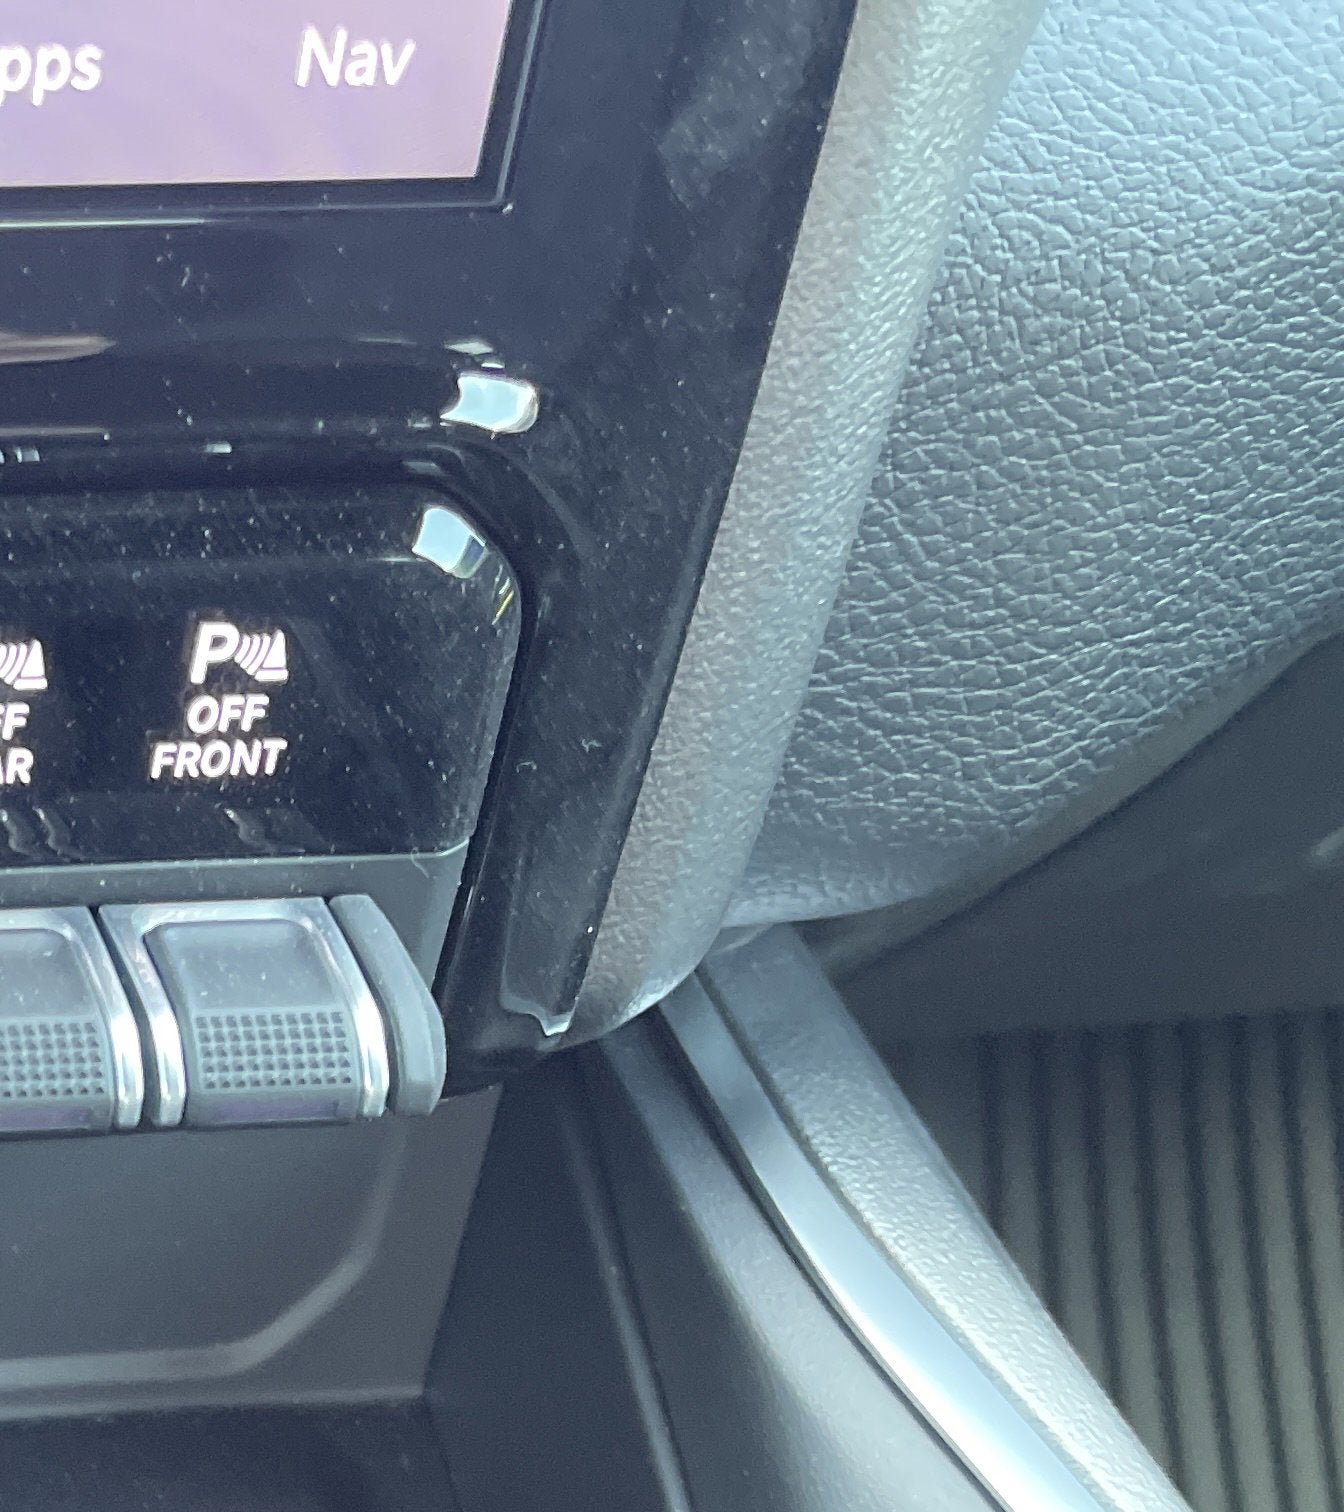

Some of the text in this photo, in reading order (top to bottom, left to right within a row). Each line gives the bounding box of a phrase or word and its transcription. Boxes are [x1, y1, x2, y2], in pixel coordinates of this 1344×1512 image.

[296, 26, 416, 88] Nav
[187, 694, 269, 733] OFF
[150, 738, 288, 779] FRONT
